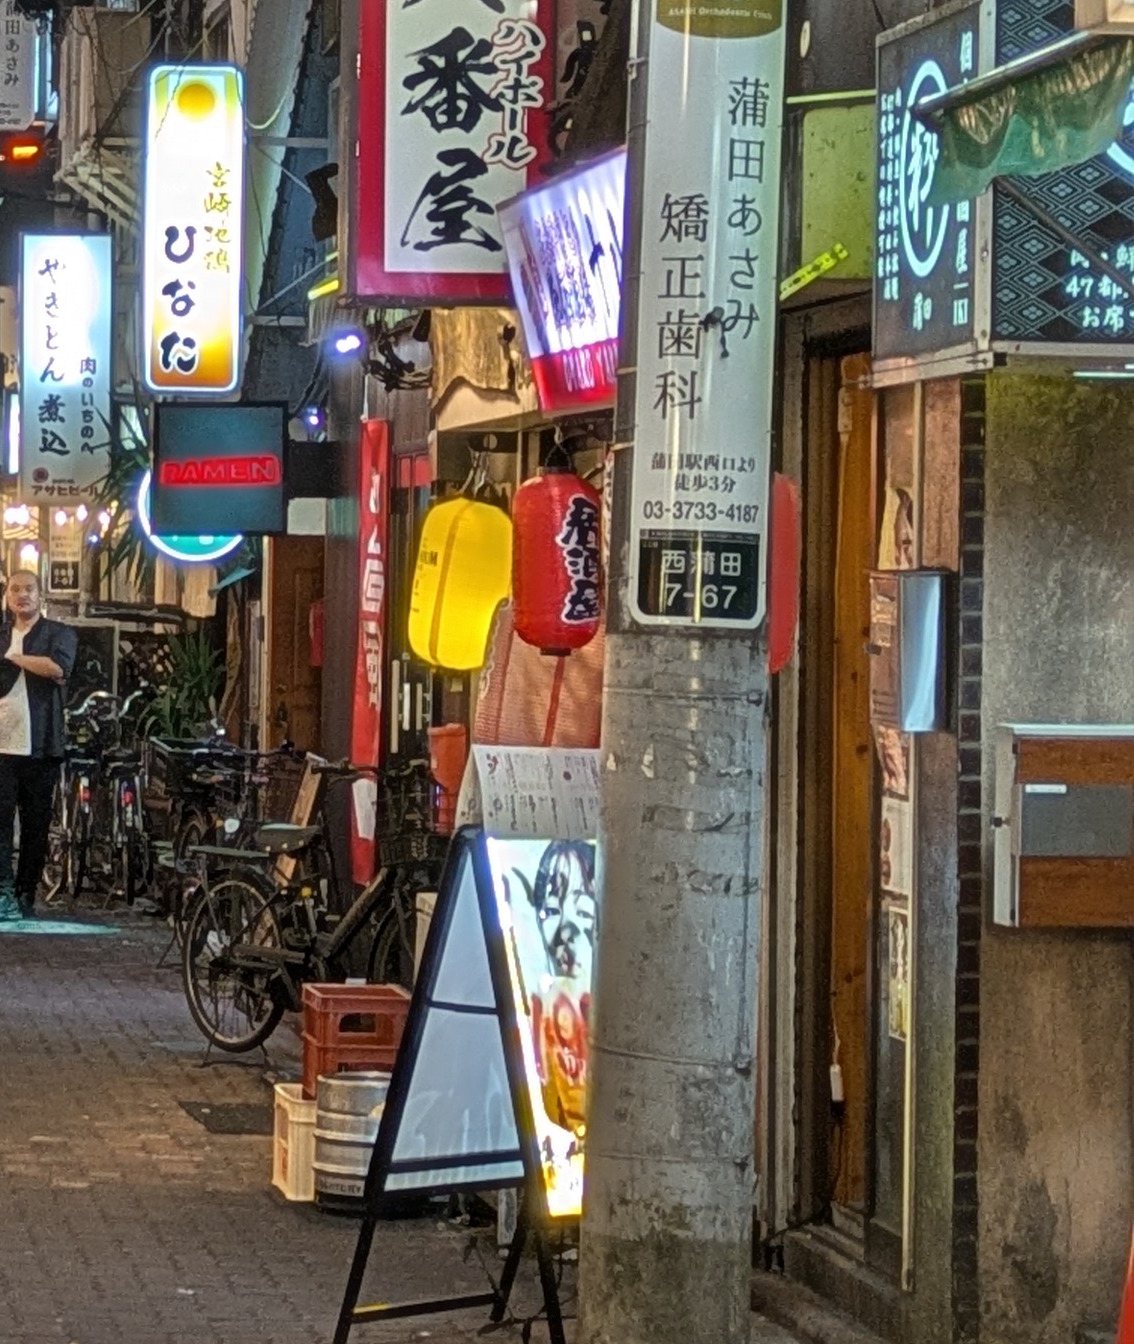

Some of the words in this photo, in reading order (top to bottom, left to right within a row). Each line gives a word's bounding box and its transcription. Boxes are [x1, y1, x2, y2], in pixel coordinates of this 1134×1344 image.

[486, 23, 542, 163] ハイボール
[728, 76, 770, 340] 蒲田あさみ
[655, 193, 710, 420] 矯正歯科
[1082, 303, 1134, 333] お席
[163, 460, 279, 485] RAMEN
[676, 475, 736, 493] 徒歩3分
[643, 501, 759, 523] 03-3733-4187
[666, 583, 738, 609] 7-67
